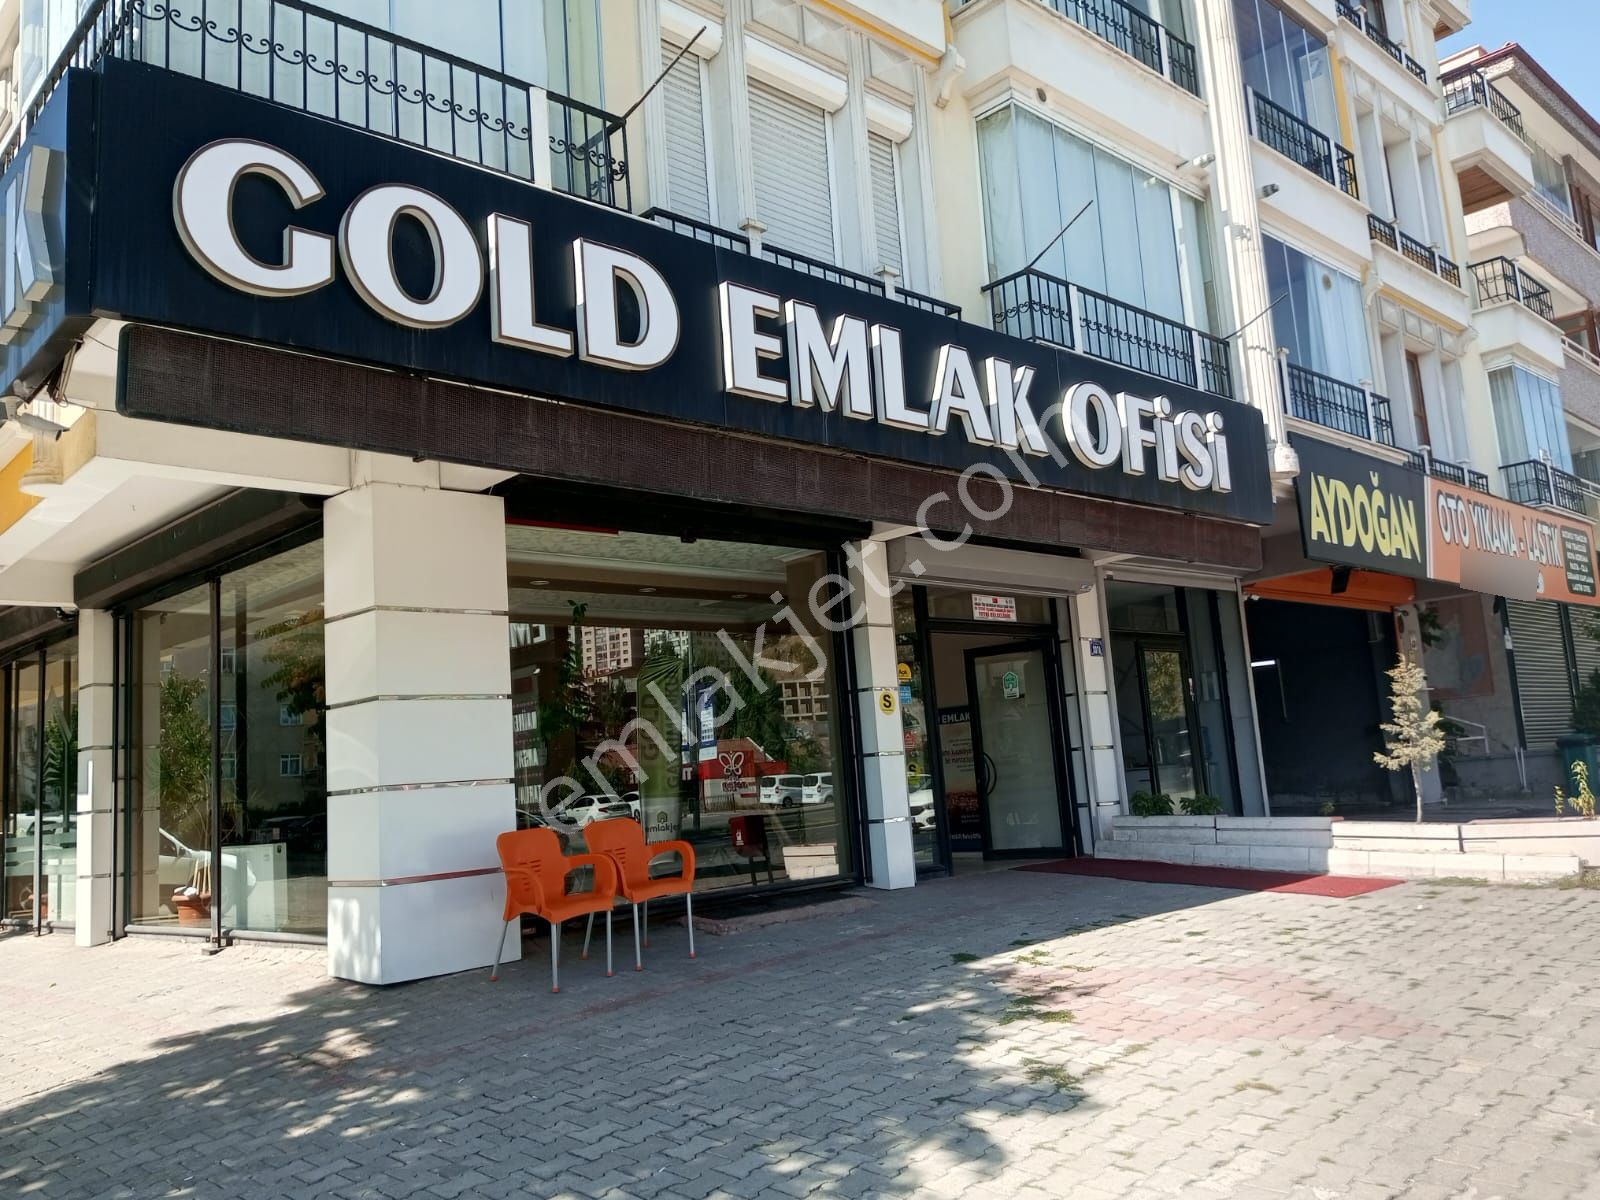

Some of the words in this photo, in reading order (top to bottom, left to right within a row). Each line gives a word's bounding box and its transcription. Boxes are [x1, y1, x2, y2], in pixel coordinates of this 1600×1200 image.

[172, 138, 681, 371] GOLD
[719, 280, 1049, 457] EMLAK
[1310, 471, 1421, 563] AYDOĞAN
[1437, 490, 1470, 549] OTO
[1468, 500, 1520, 558] YIKAMA
[883, 694, 892, 708] S
